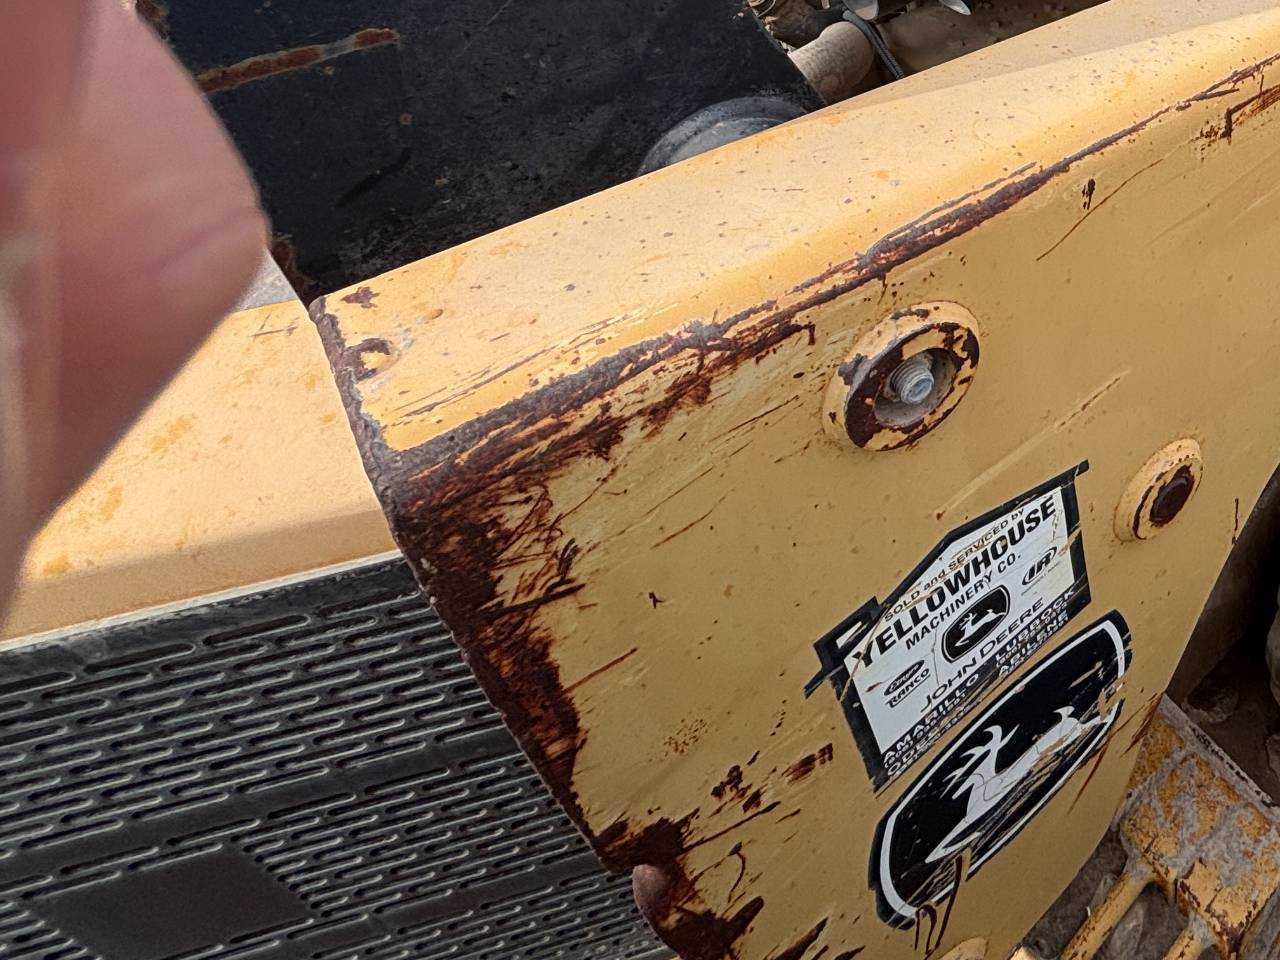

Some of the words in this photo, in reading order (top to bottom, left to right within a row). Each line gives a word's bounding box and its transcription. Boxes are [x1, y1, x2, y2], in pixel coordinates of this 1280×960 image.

[851, 495, 1056, 669] YELLOWHOUSE
[884, 591, 920, 622] SOLD
[923, 569, 946, 591] and
[948, 520, 1009, 569] SERVICED
[1011, 508, 1024, 521] by
[906, 570, 992, 650] MACHINERY
[998, 552, 1021, 574] CO.
[920, 657, 977, 713] JOHN
[980, 597, 1043, 659] DEERE
[995, 587, 1077, 660] LUBBOCK
[883, 673, 978, 764] AMARILLO
